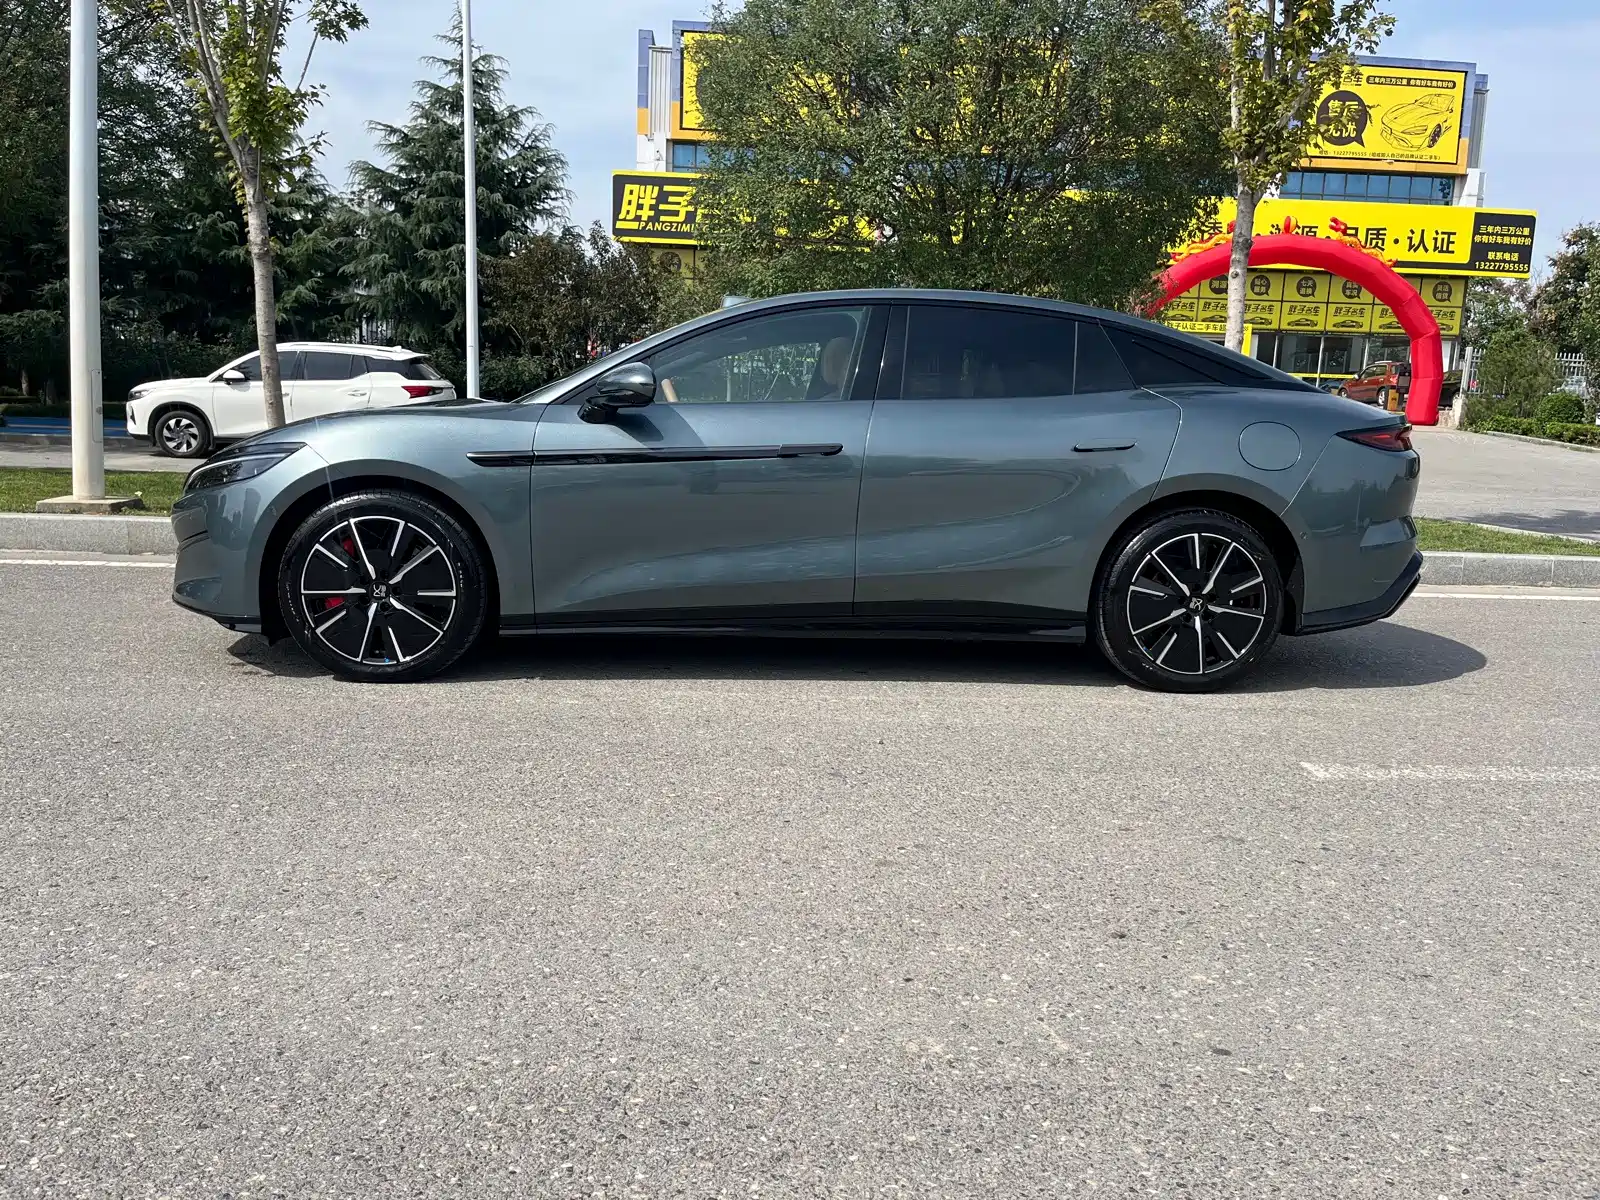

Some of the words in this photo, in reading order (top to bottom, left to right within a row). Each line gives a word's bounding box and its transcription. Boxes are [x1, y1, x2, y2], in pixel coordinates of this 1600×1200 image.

[1369, 76, 1408, 85] 三年内三万公里
[1410, 78, 1454, 88] 你有好车我有好价
[1479, 225, 1530, 236] 三年内三万公里
[1474, 235, 1532, 246] 你有好车我有好价
[1487, 252, 1519, 262] 联系电话
[1475, 262, 1528, 272] 13227795555
[1289, 304, 1320, 314] 胖子名车
[1334, 307, 1366, 316] 胖子名车
[1431, 309, 1456, 318] 子名车
